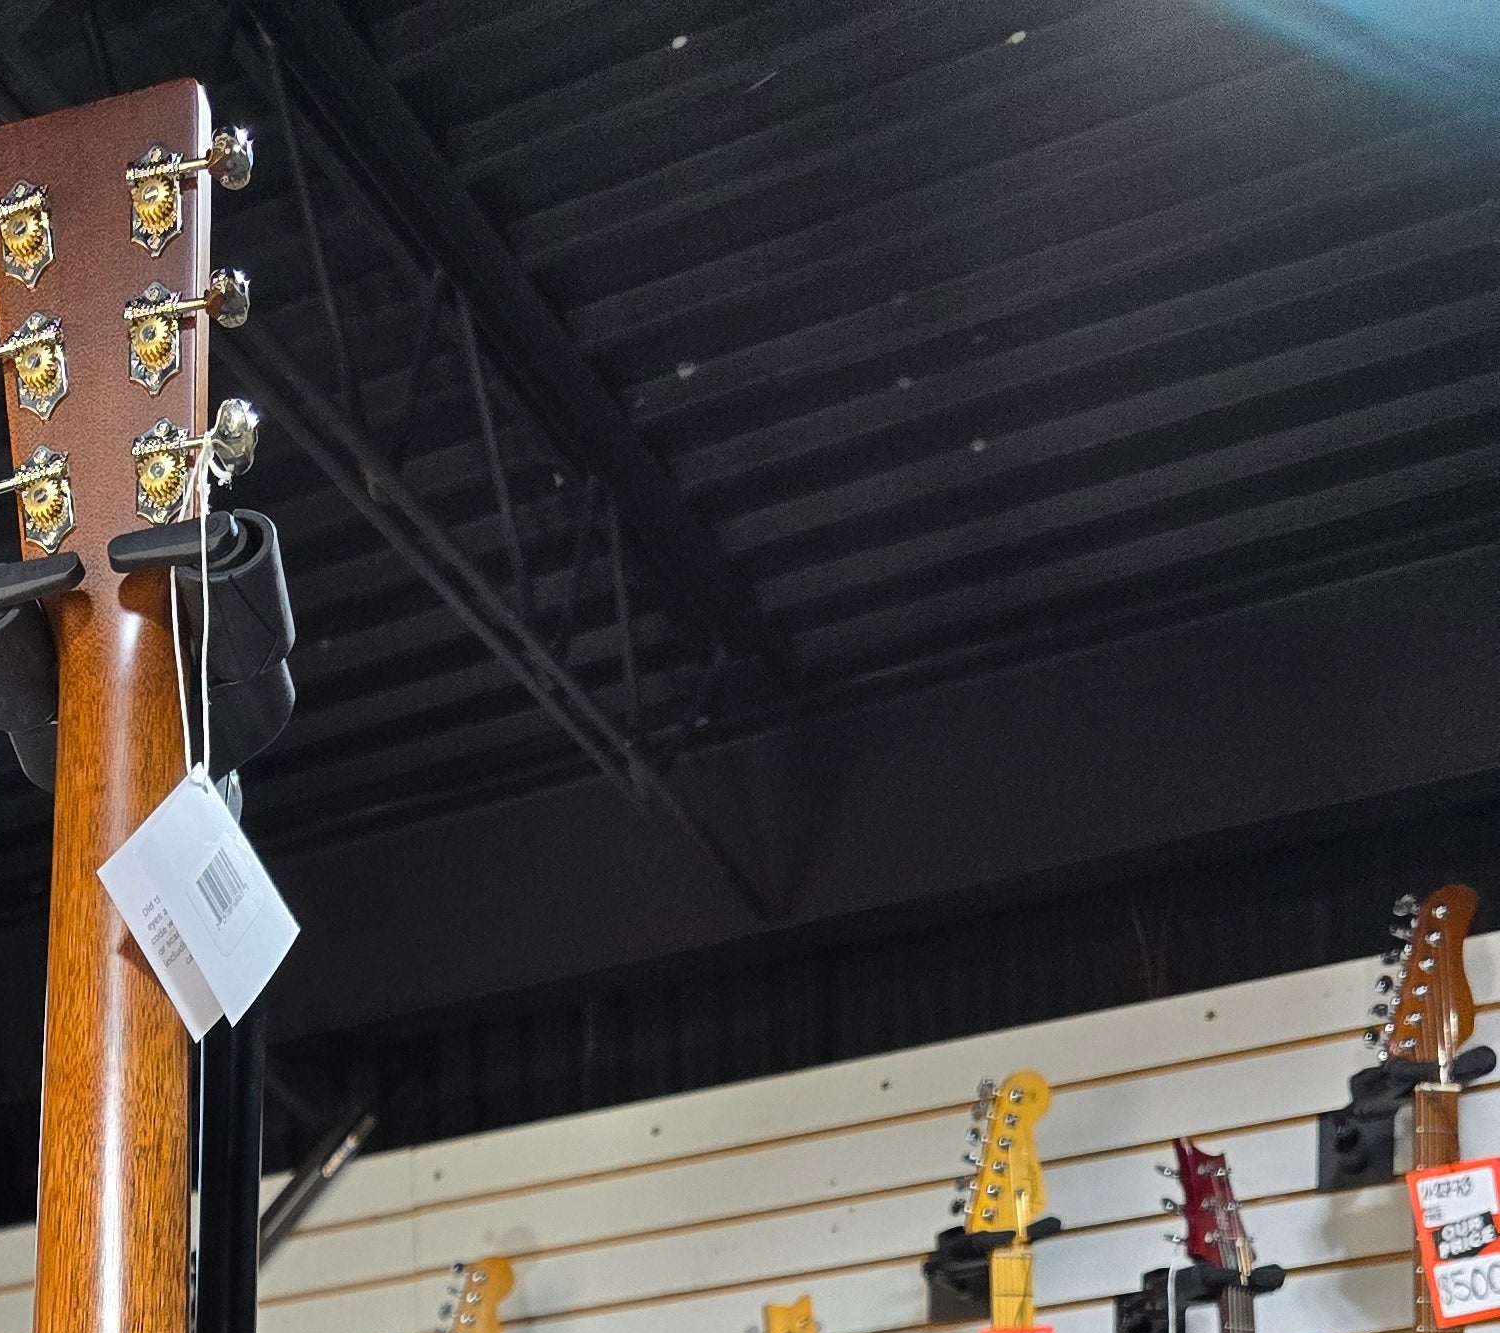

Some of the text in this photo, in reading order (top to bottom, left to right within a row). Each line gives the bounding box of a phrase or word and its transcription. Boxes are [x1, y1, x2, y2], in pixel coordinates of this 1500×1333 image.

[147, 913, 162, 931] eyes
[151, 927, 167, 945] code
[1441, 1216, 1484, 1242] OUR
[1438, 1224, 1496, 1259] PRICE
